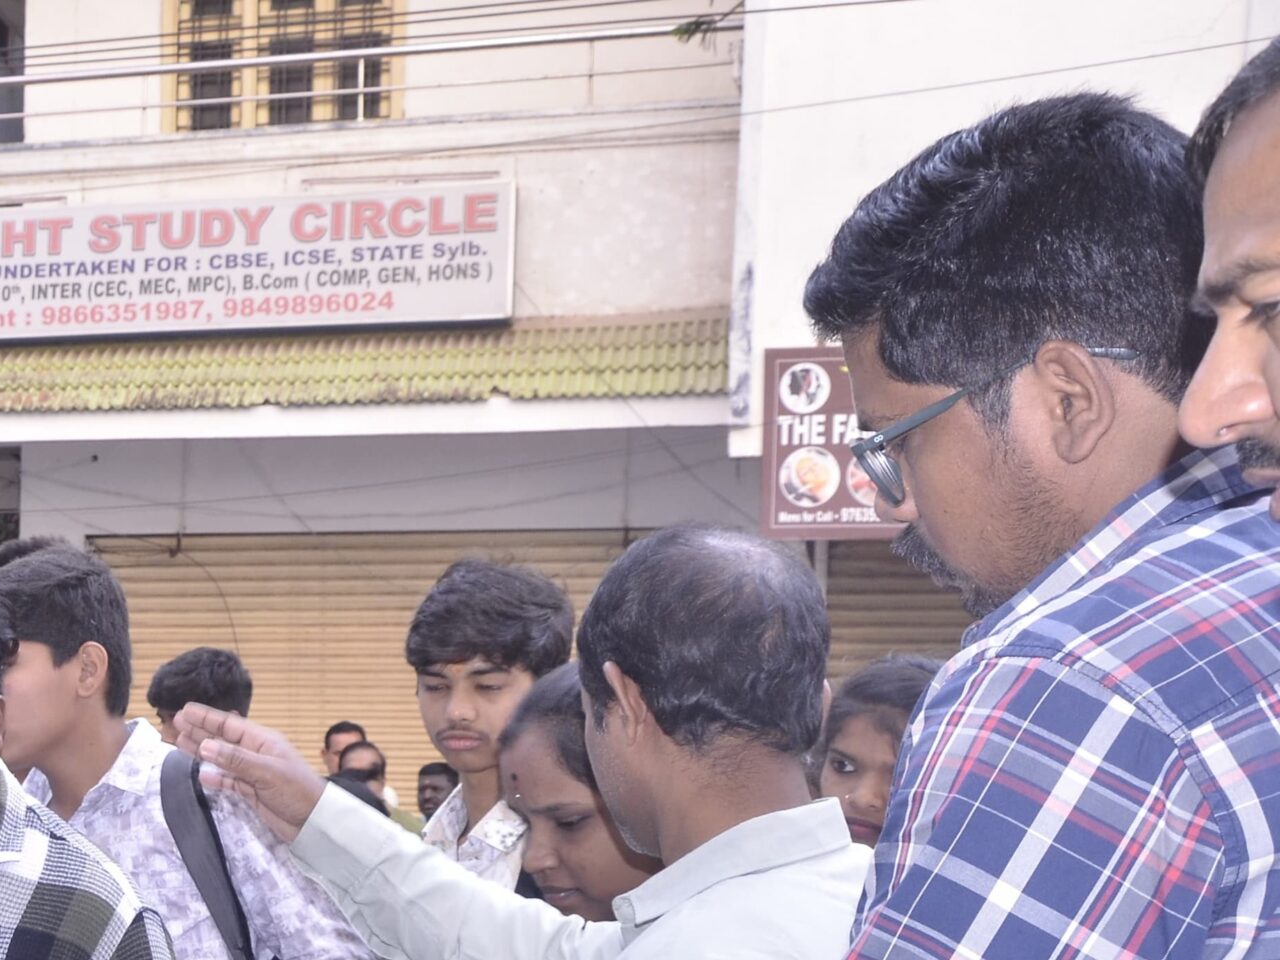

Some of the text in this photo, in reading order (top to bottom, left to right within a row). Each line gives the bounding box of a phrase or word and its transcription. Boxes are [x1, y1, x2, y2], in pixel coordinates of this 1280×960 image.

[88, 205, 273, 254] STUDY
[290, 193, 498, 243] CIRCLE
[144, 256, 188, 273] FOR
[209, 251, 276, 270] CBSE,
[284, 248, 342, 267] ICSE,
[352, 243, 424, 262] STATE
[433, 240, 488, 262] Sylb.
[31, 282, 82, 301] INTER
[139, 278, 181, 297] MEC,
[188, 274, 237, 296] MPC),
[243, 273, 299, 291] B.Com
[316, 269, 371, 289] COMP,
[378, 265, 421, 286] GEN,
[428, 262, 480, 281] HONS
[41, 300, 212, 326] 9866351987,
[223, 291, 394, 318] 9849896024
[777, 413, 826, 446] THE
